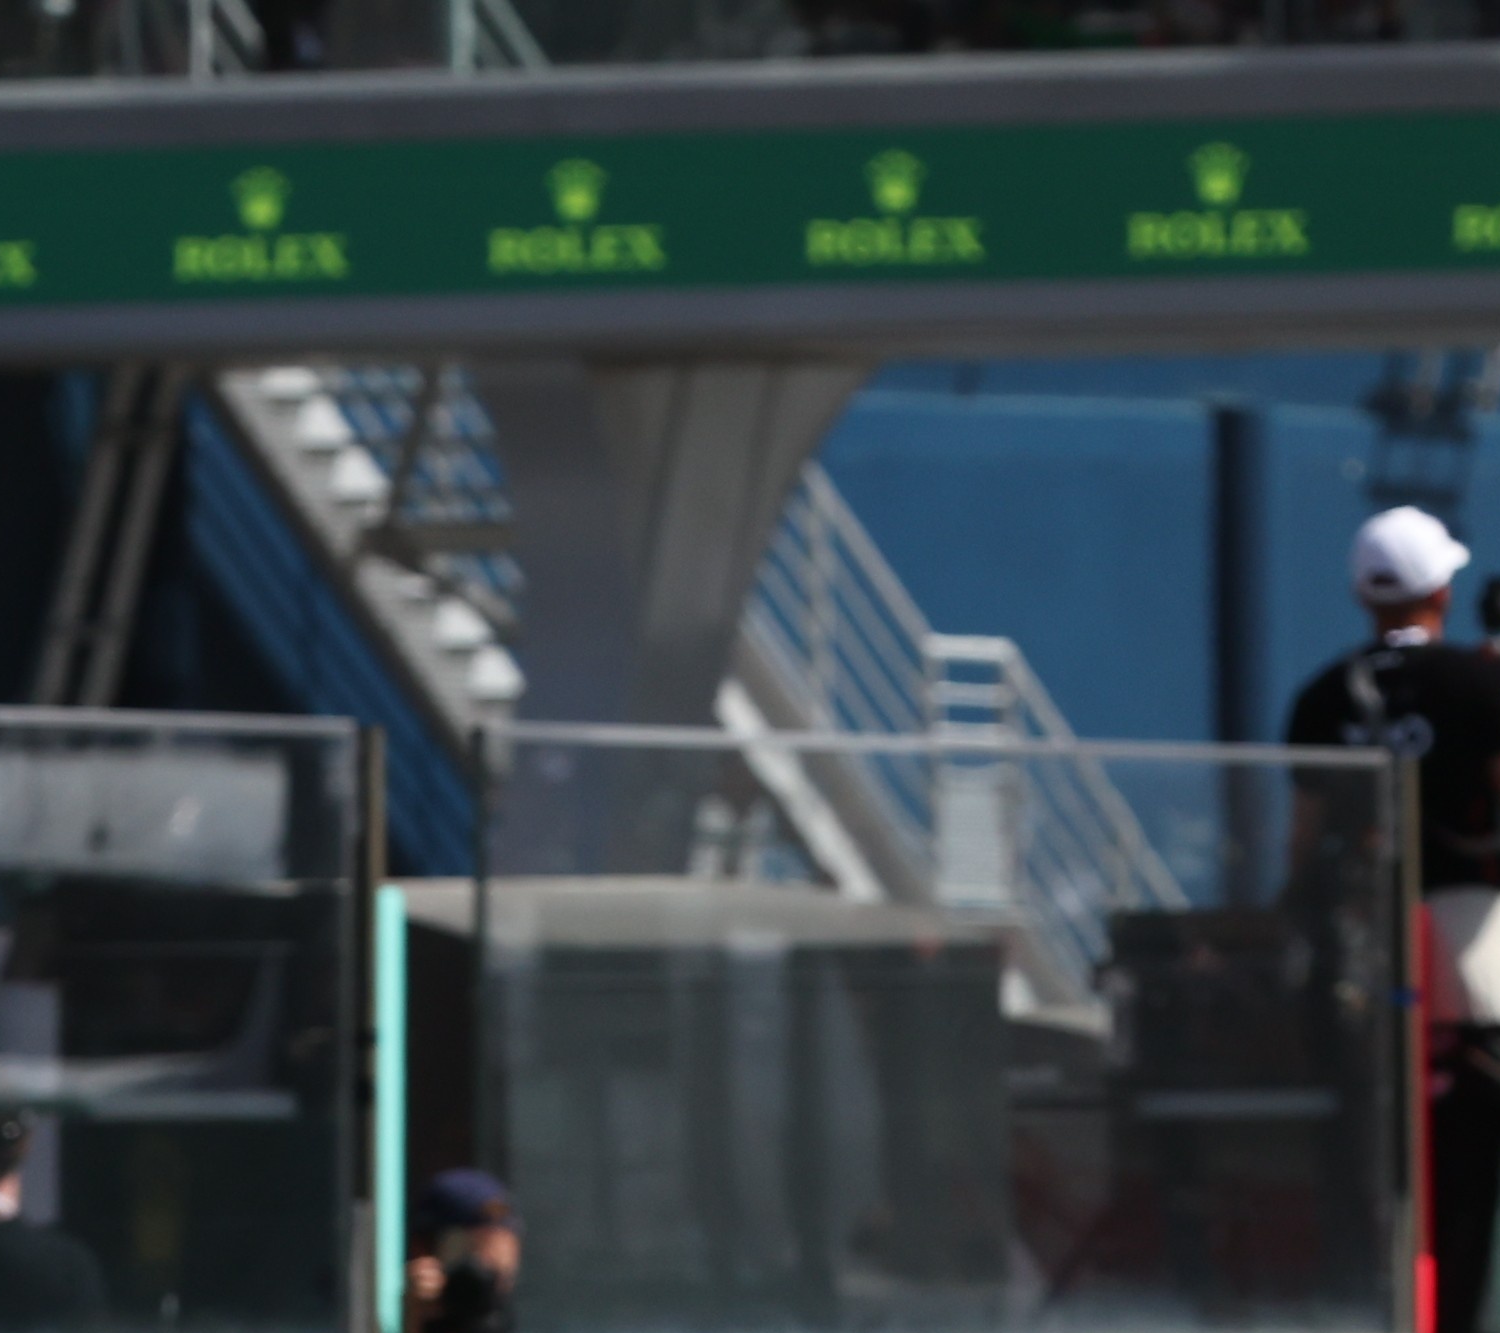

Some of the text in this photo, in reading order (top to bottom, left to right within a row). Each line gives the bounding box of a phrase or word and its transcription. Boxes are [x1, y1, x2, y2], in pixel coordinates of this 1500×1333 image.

[172, 233, 350, 281] ROLEX
[486, 223, 667, 274] ROLEX
[805, 216, 986, 265] ROLEX
[1126, 209, 1310, 258] ROLEX
